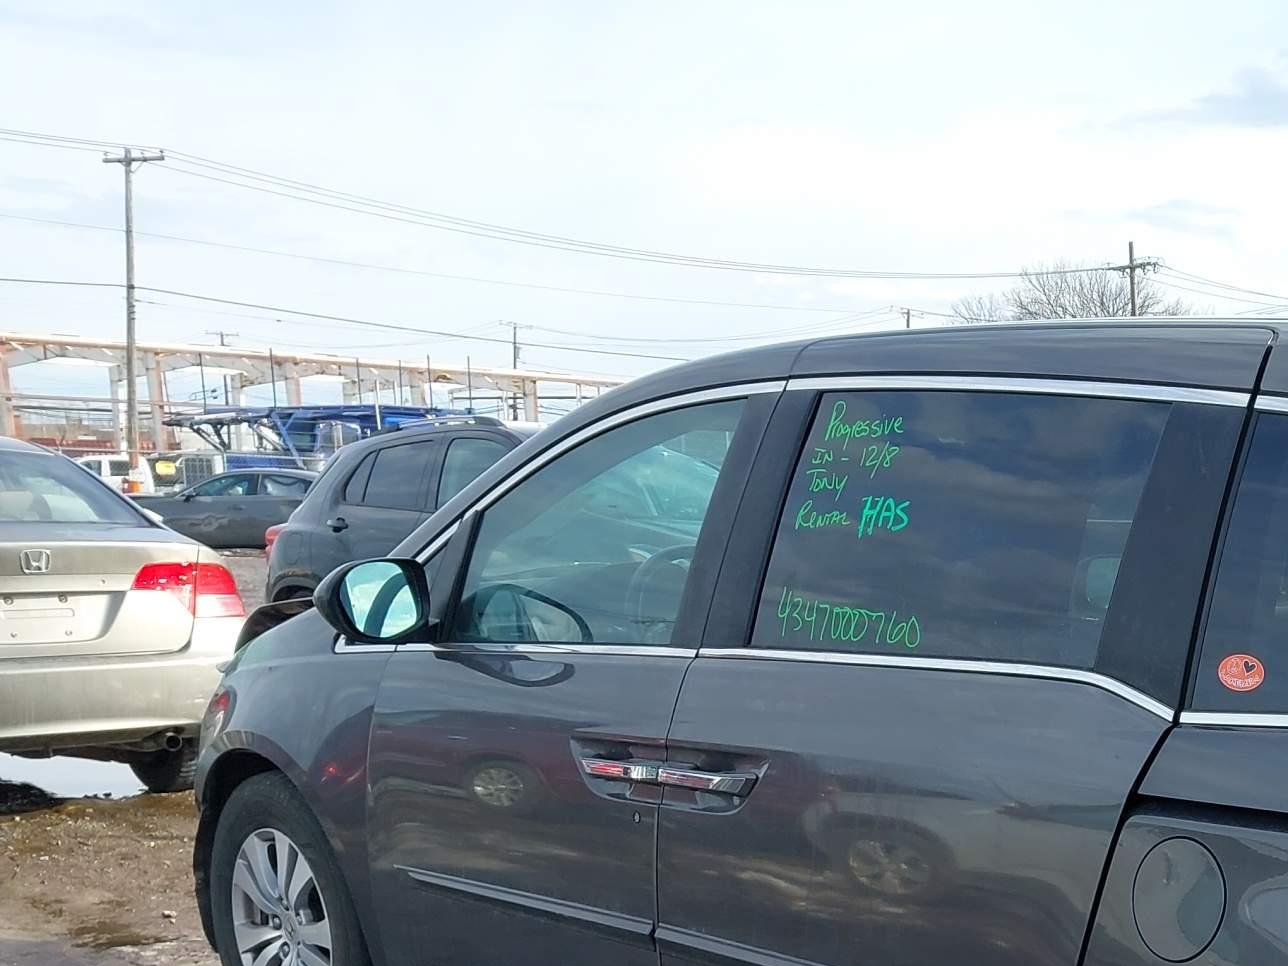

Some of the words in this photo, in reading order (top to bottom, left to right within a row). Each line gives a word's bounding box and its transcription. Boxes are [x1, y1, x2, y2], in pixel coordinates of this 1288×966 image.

[825, 401, 904, 450] Progressive
[860, 441, 900, 479] 12/8
[778, 587, 920, 648] 4347000760
